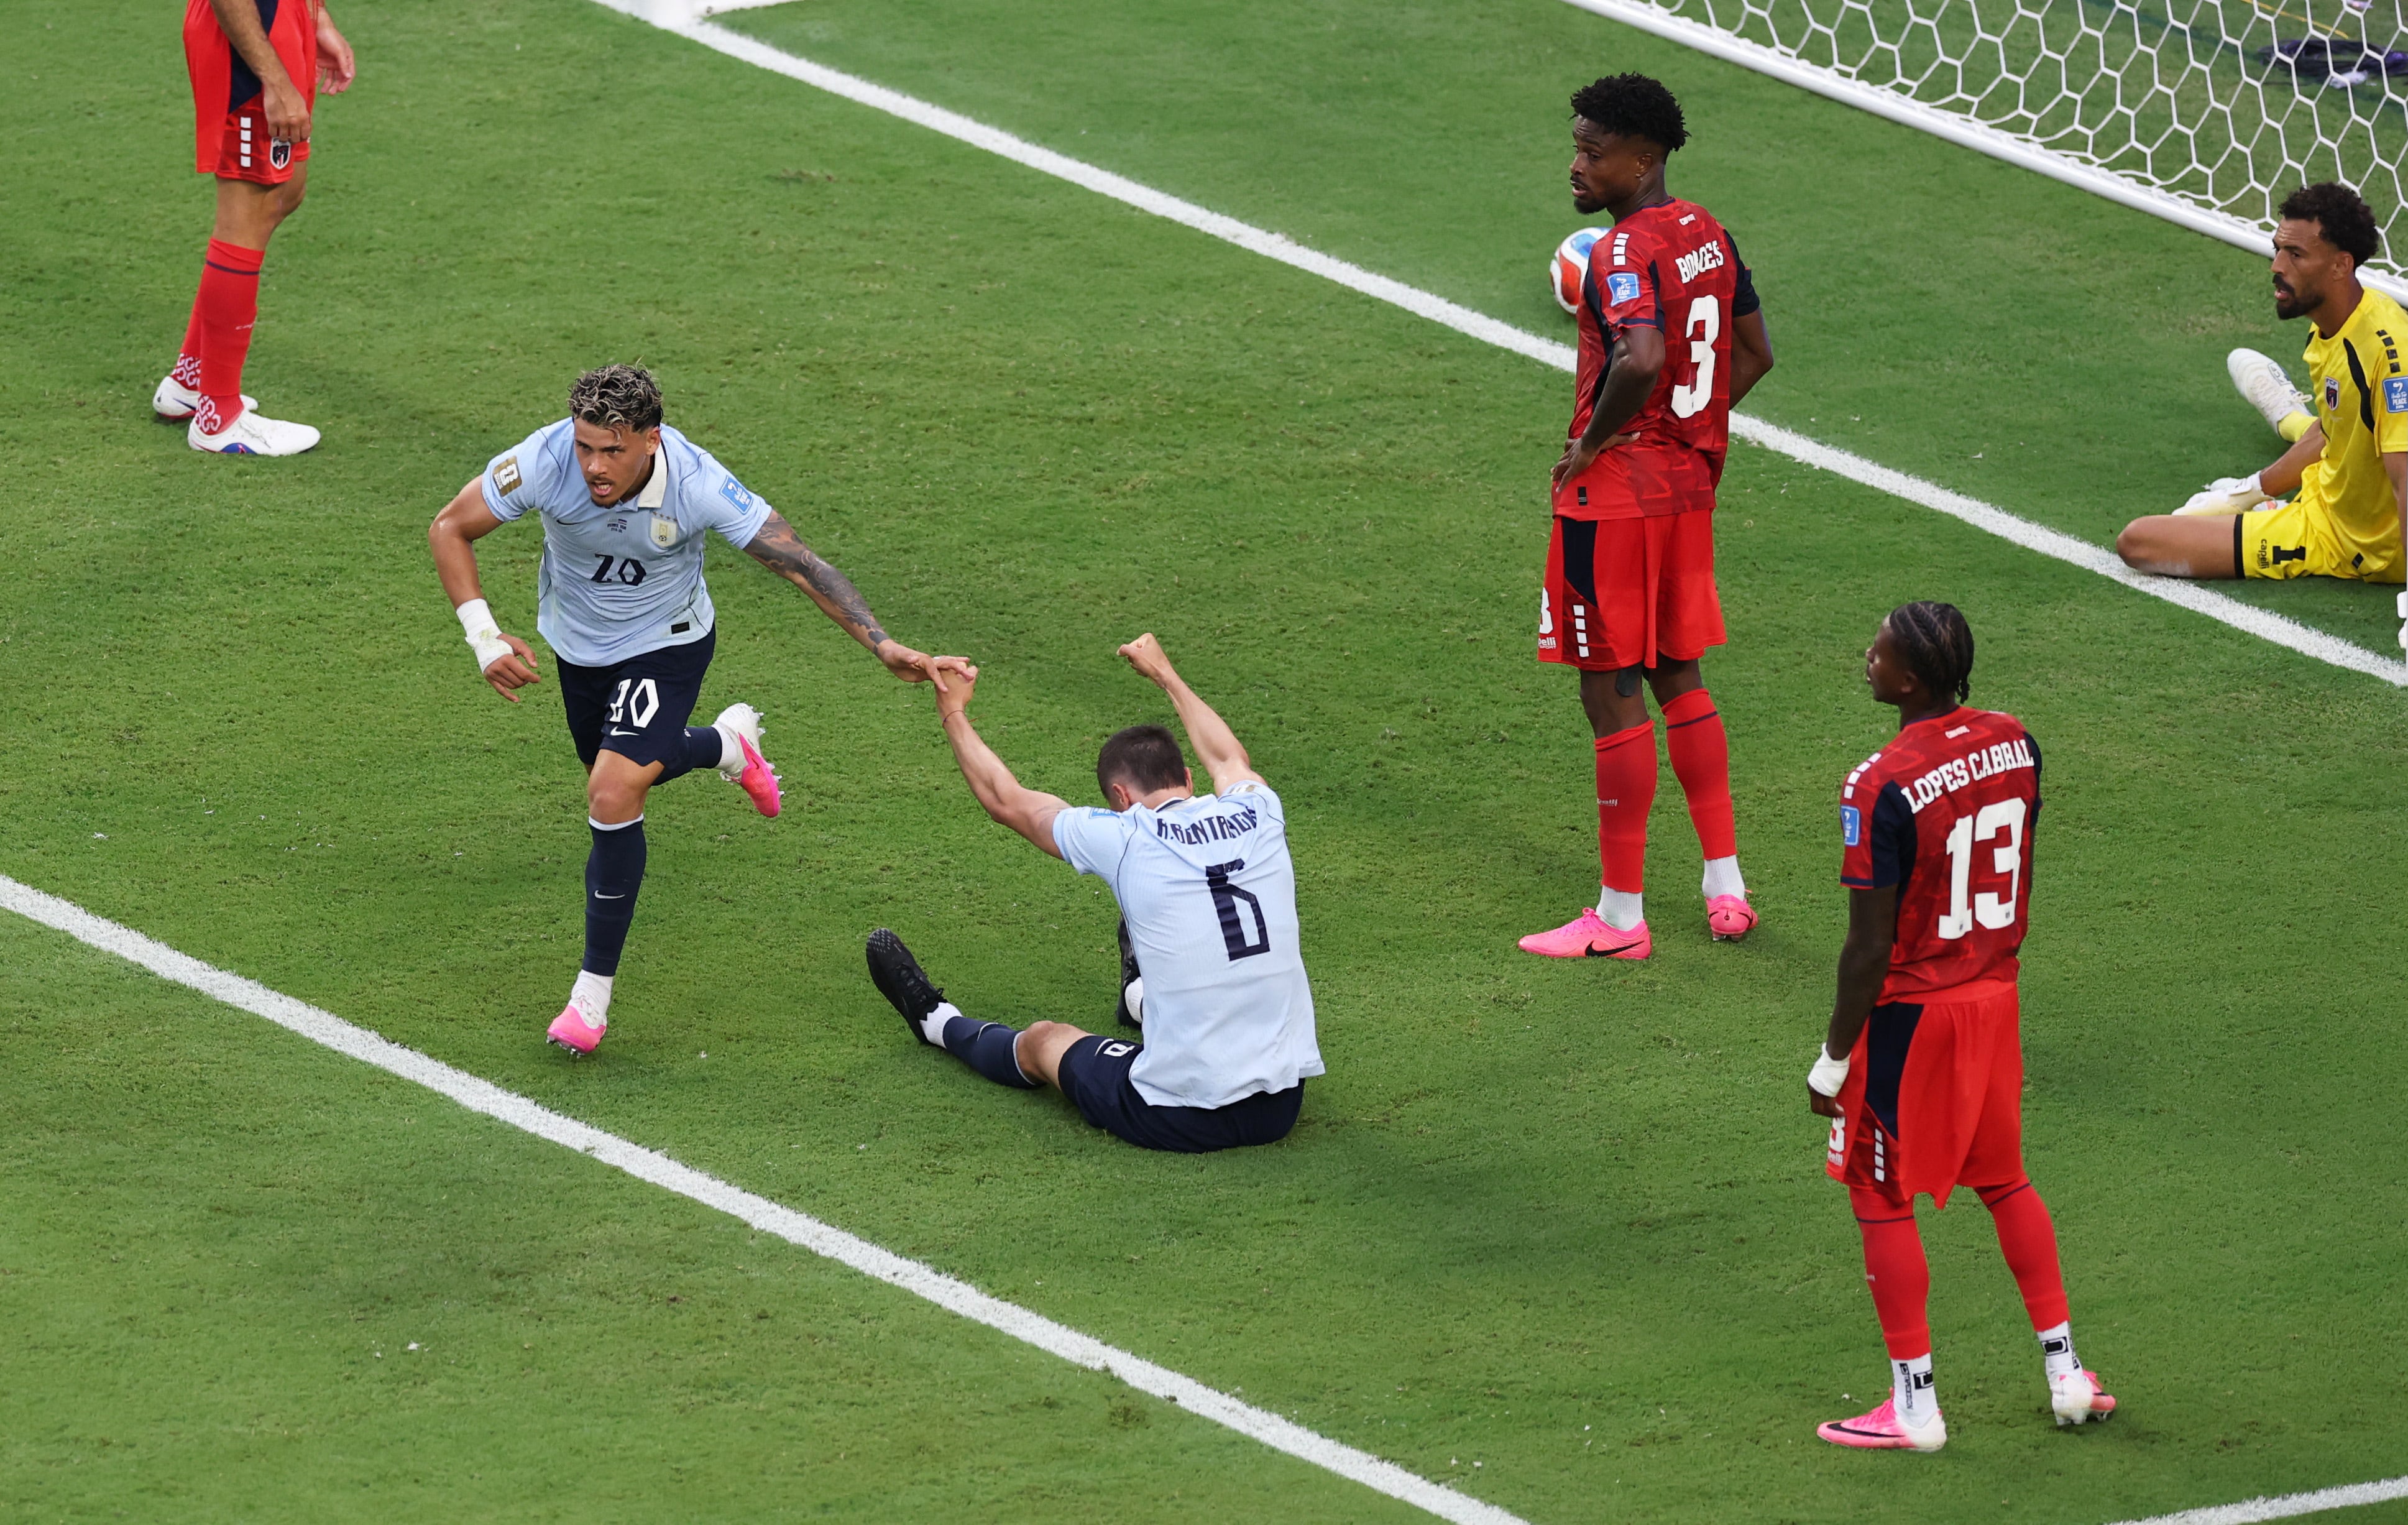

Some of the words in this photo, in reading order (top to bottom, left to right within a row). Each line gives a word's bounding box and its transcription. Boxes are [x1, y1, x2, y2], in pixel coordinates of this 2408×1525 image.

[1671, 294, 1720, 418] 3
[591, 553, 647, 586] 20
[2258, 538, 2269, 569] capelli
[2272, 545, 2306, 565] 1
[1538, 637, 1556, 648] pelli
[1900, 758, 1970, 814] LOPES
[1968, 739, 2035, 781] CABRAL
[1937, 796, 2027, 940] 13
[1205, 858, 1271, 962] 6
